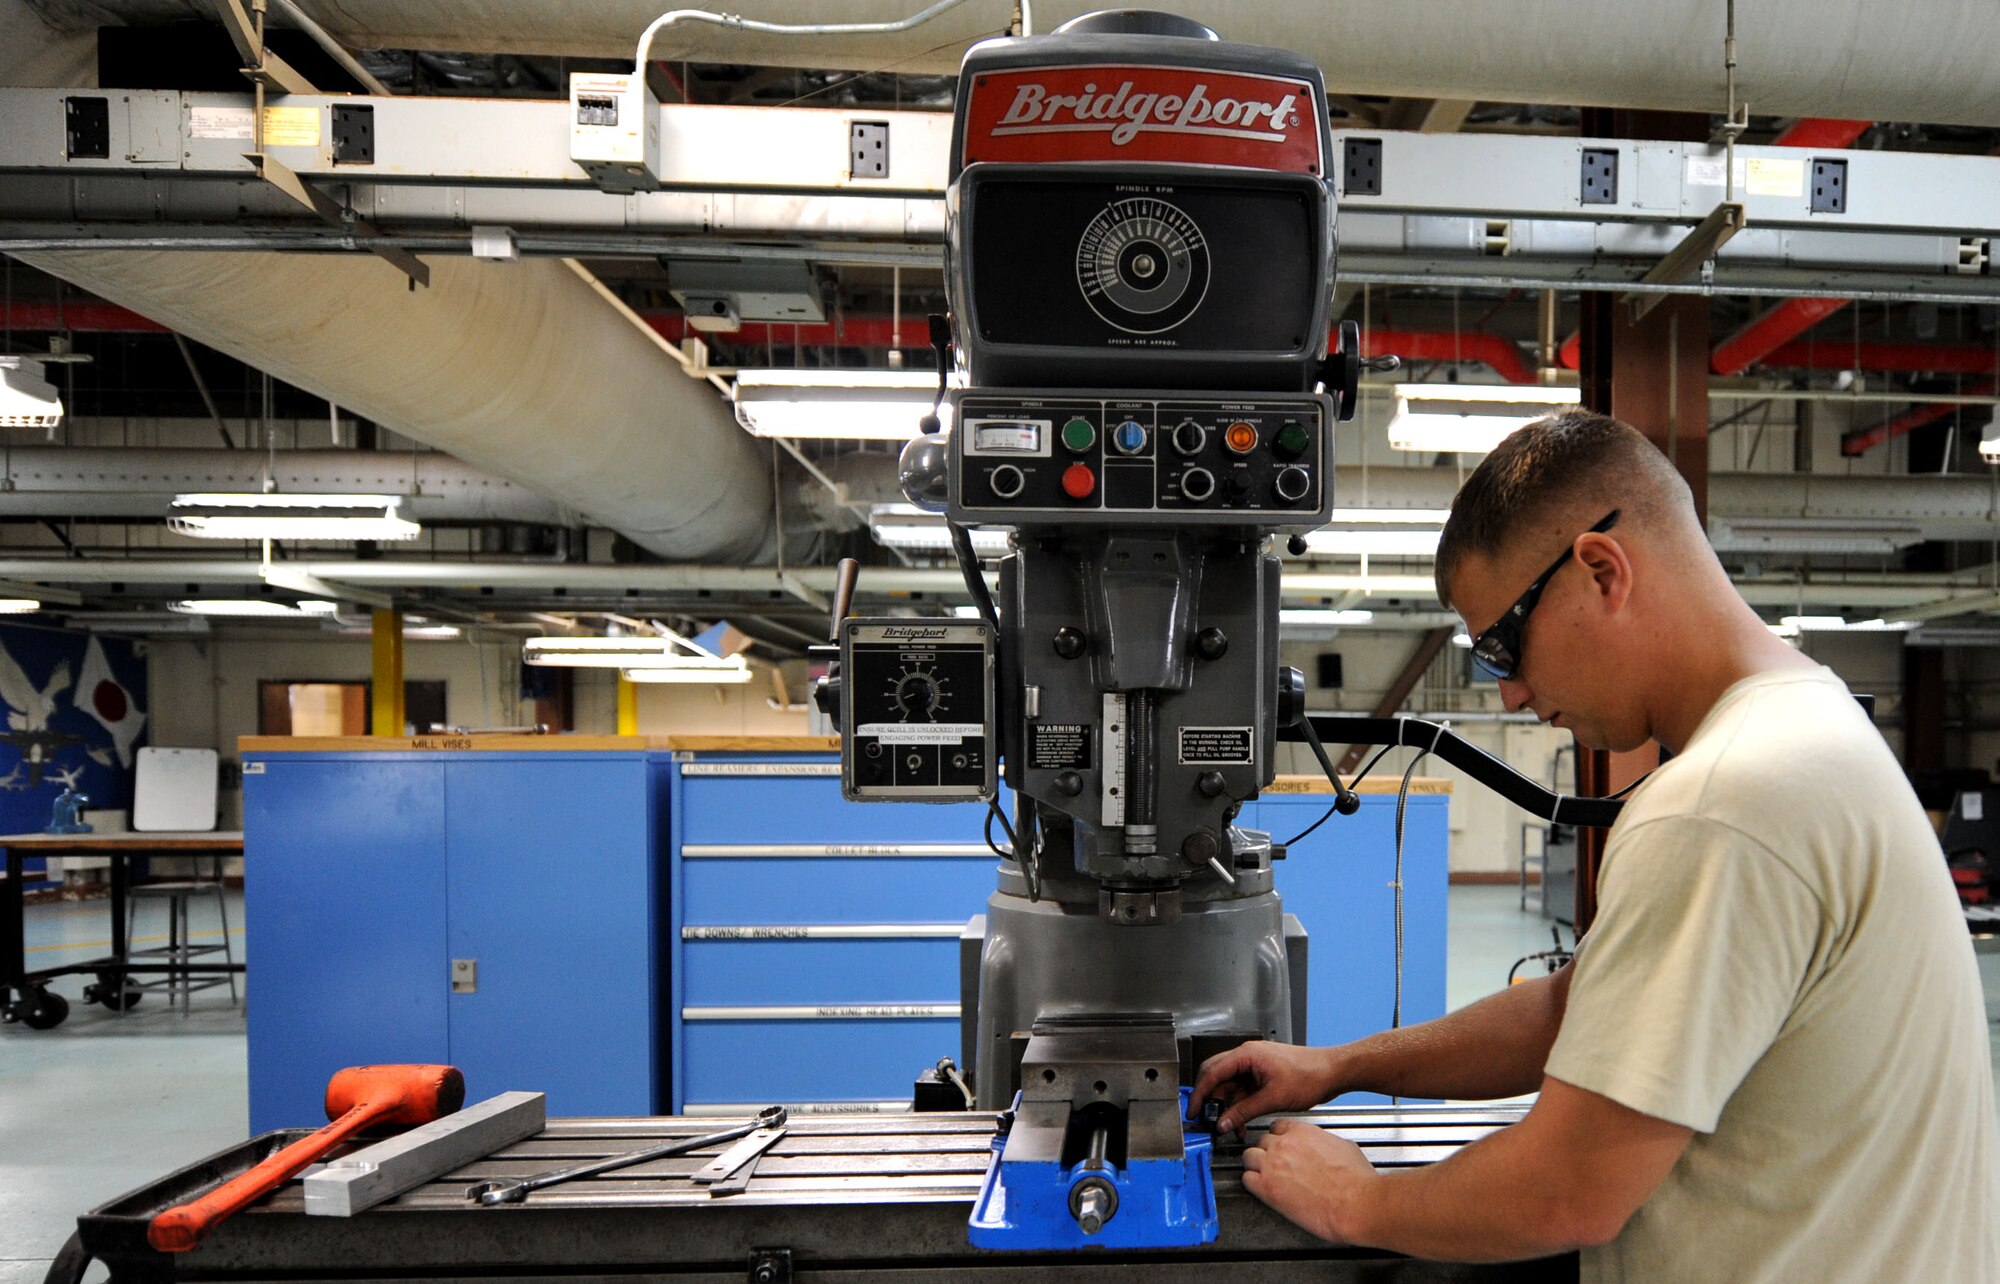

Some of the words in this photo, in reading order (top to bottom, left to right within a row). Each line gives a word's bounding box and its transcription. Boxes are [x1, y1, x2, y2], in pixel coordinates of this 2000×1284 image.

[992, 80, 1296, 146] Bridgeport
[883, 627, 948, 642] Bridgeport
[1036, 725, 1082, 733] WARNING
[412, 739, 437, 749] MILL
[442, 739, 472, 749] VISES
[828, 739, 841, 749] MI
[765, 765, 818, 773] EXPANSION
[825, 845, 863, 855] COLLET
[867, 845, 900, 855] BLOCK
[685, 928, 701, 938] TIE
[704, 928, 746, 939] DOWNS/
[752, 927, 808, 938] WRENCHES
[816, 1008, 862, 1017] INDEXING
[866, 1008, 892, 1017] HEAD
[897, 1008, 933, 1017] PLATES
[812, 1104, 879, 1114] ACCESSORIES
